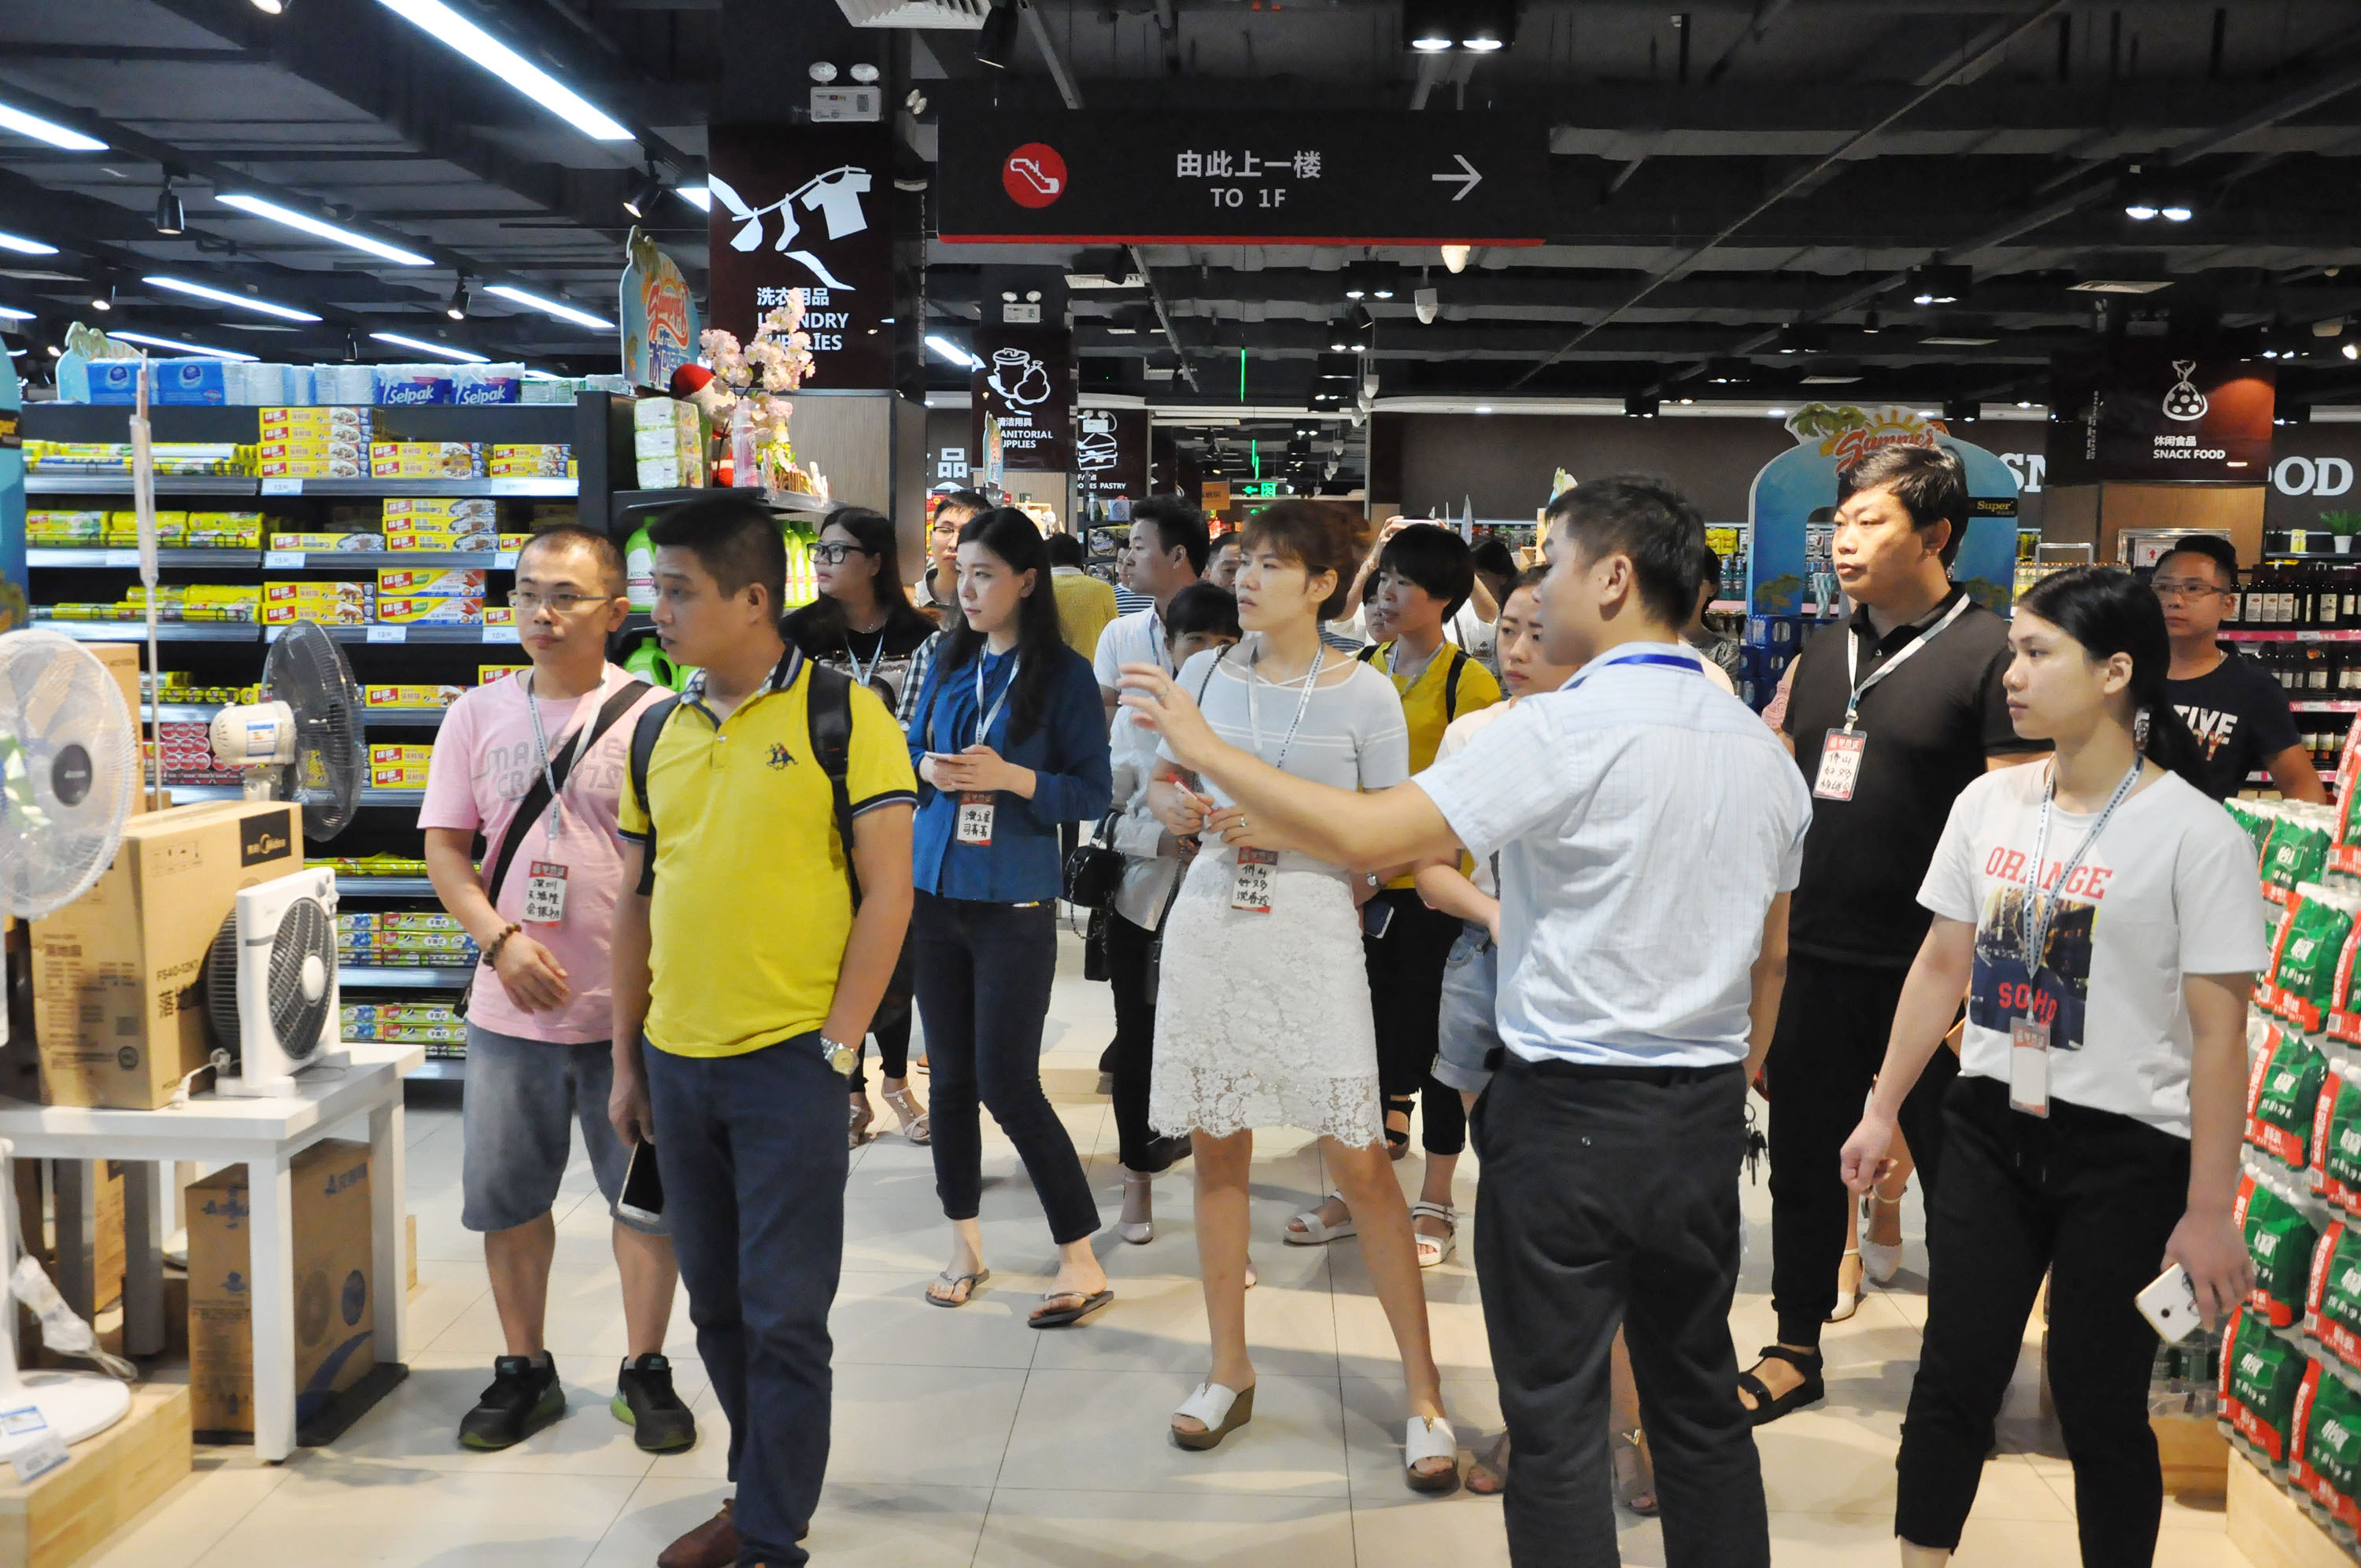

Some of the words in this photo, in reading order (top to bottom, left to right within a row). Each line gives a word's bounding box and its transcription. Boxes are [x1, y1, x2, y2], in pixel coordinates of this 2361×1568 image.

[1177, 149, 1321, 179] 由此上一楼
[1210, 188, 1243, 208] TO
[1259, 188, 1287, 208] 1F
[390, 385, 434, 404] Selpak
[462, 385, 506, 404] Selpak
[1000, 430, 1053, 439] ANITORIAL
[1002, 440, 1036, 448] UPPLIES
[2153, 435, 2197, 447] 休闲食品
[937, 448, 968, 478] 品
[2153, 449, 2191, 459] SNACK
[2193, 449, 2226, 459] FOOD
